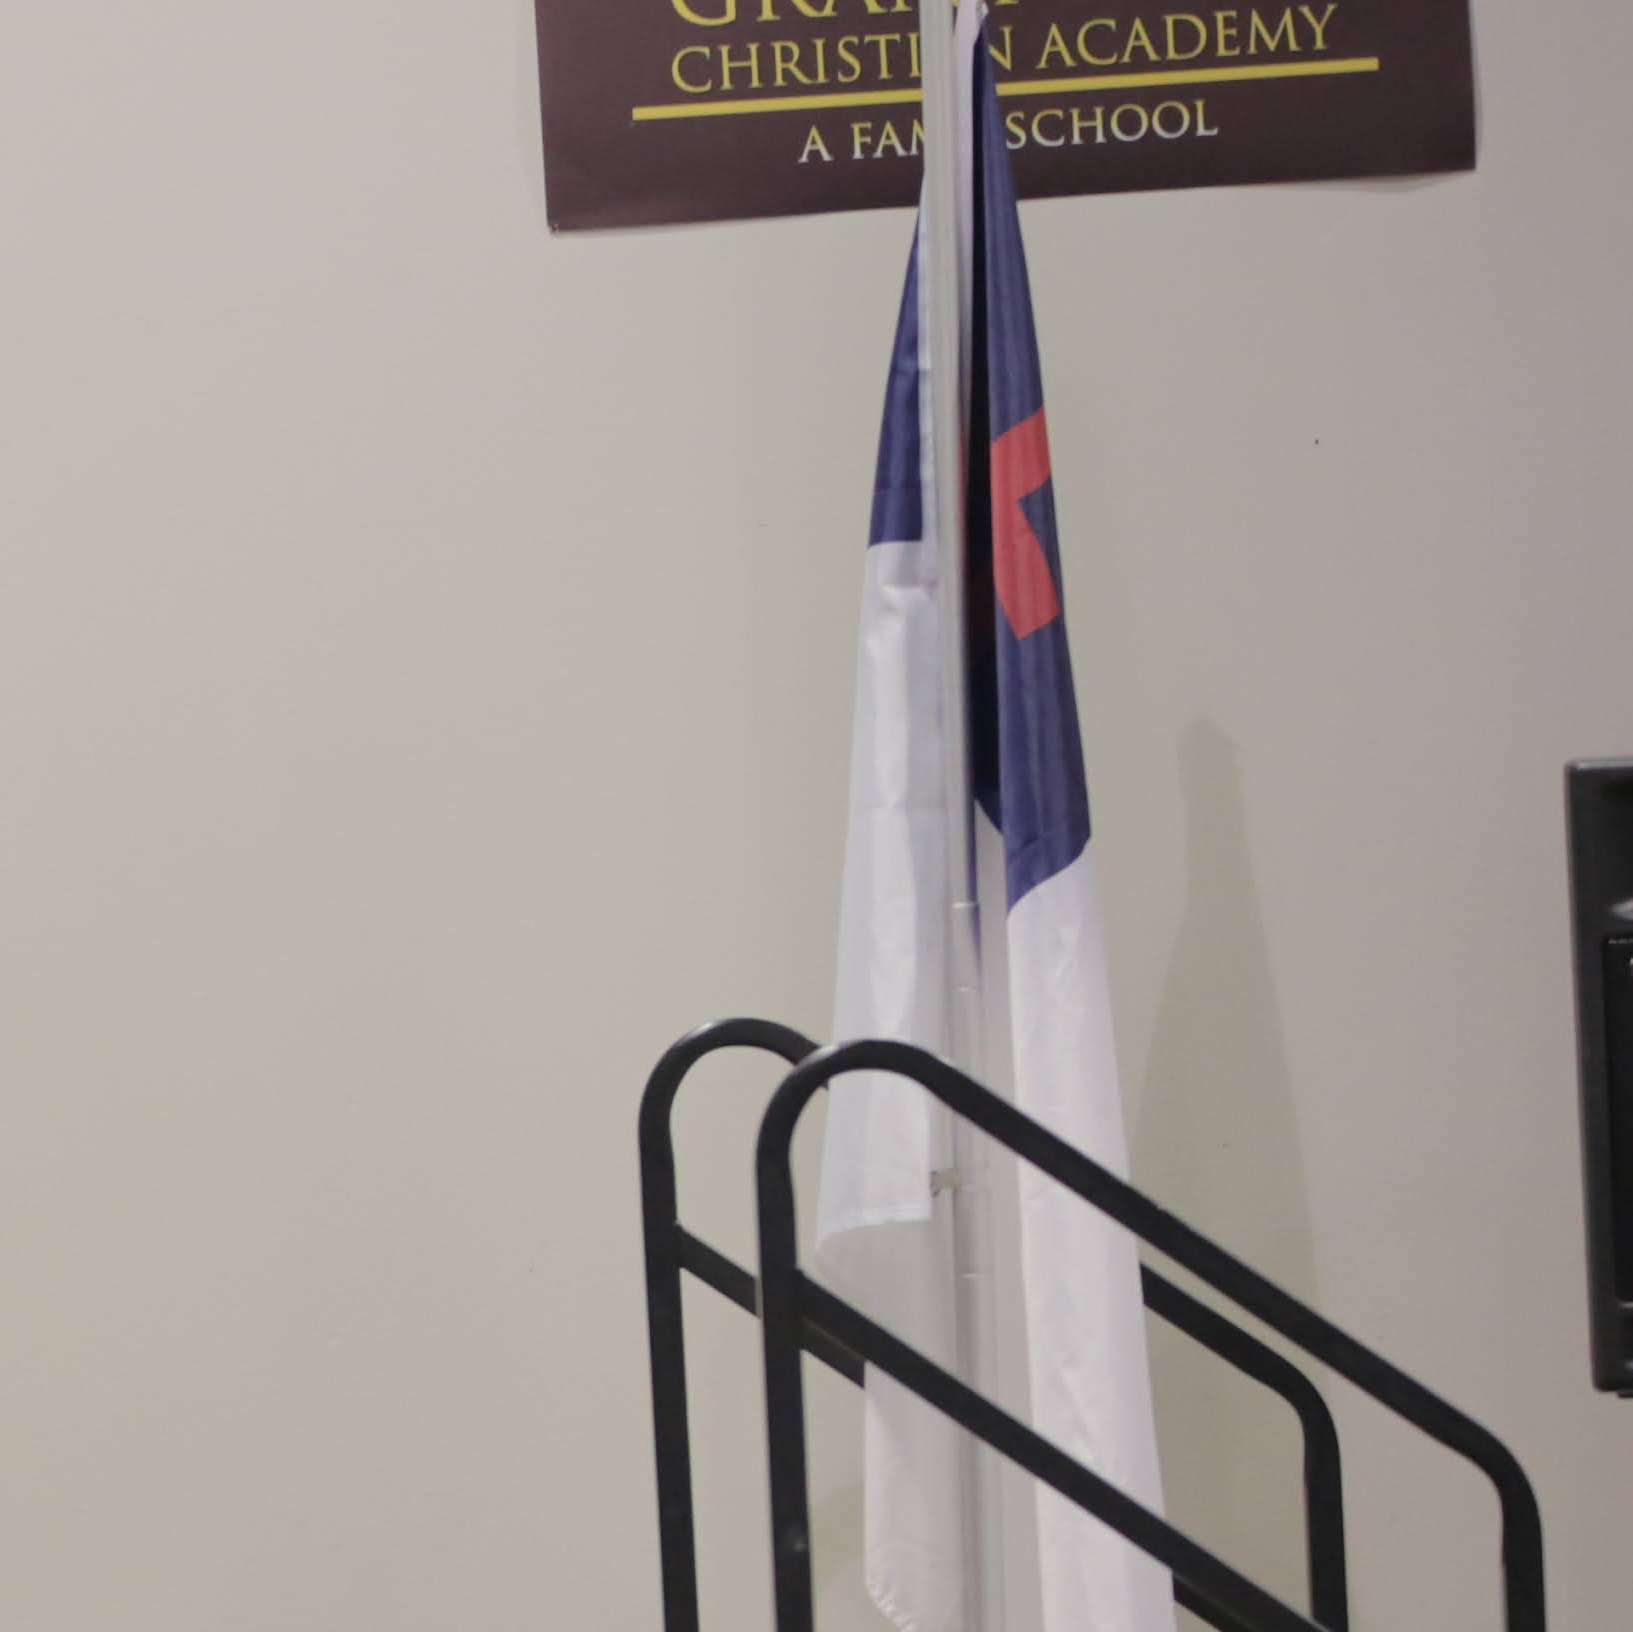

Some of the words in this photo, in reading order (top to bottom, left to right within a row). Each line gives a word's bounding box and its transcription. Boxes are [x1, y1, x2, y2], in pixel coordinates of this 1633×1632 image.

[671, 26, 1014, 93] CHRISTIN
[1036, 4, 1338, 70] ACADEMY
[798, 125, 834, 163] A
[1005, 99, 1219, 150] SCHOOL
